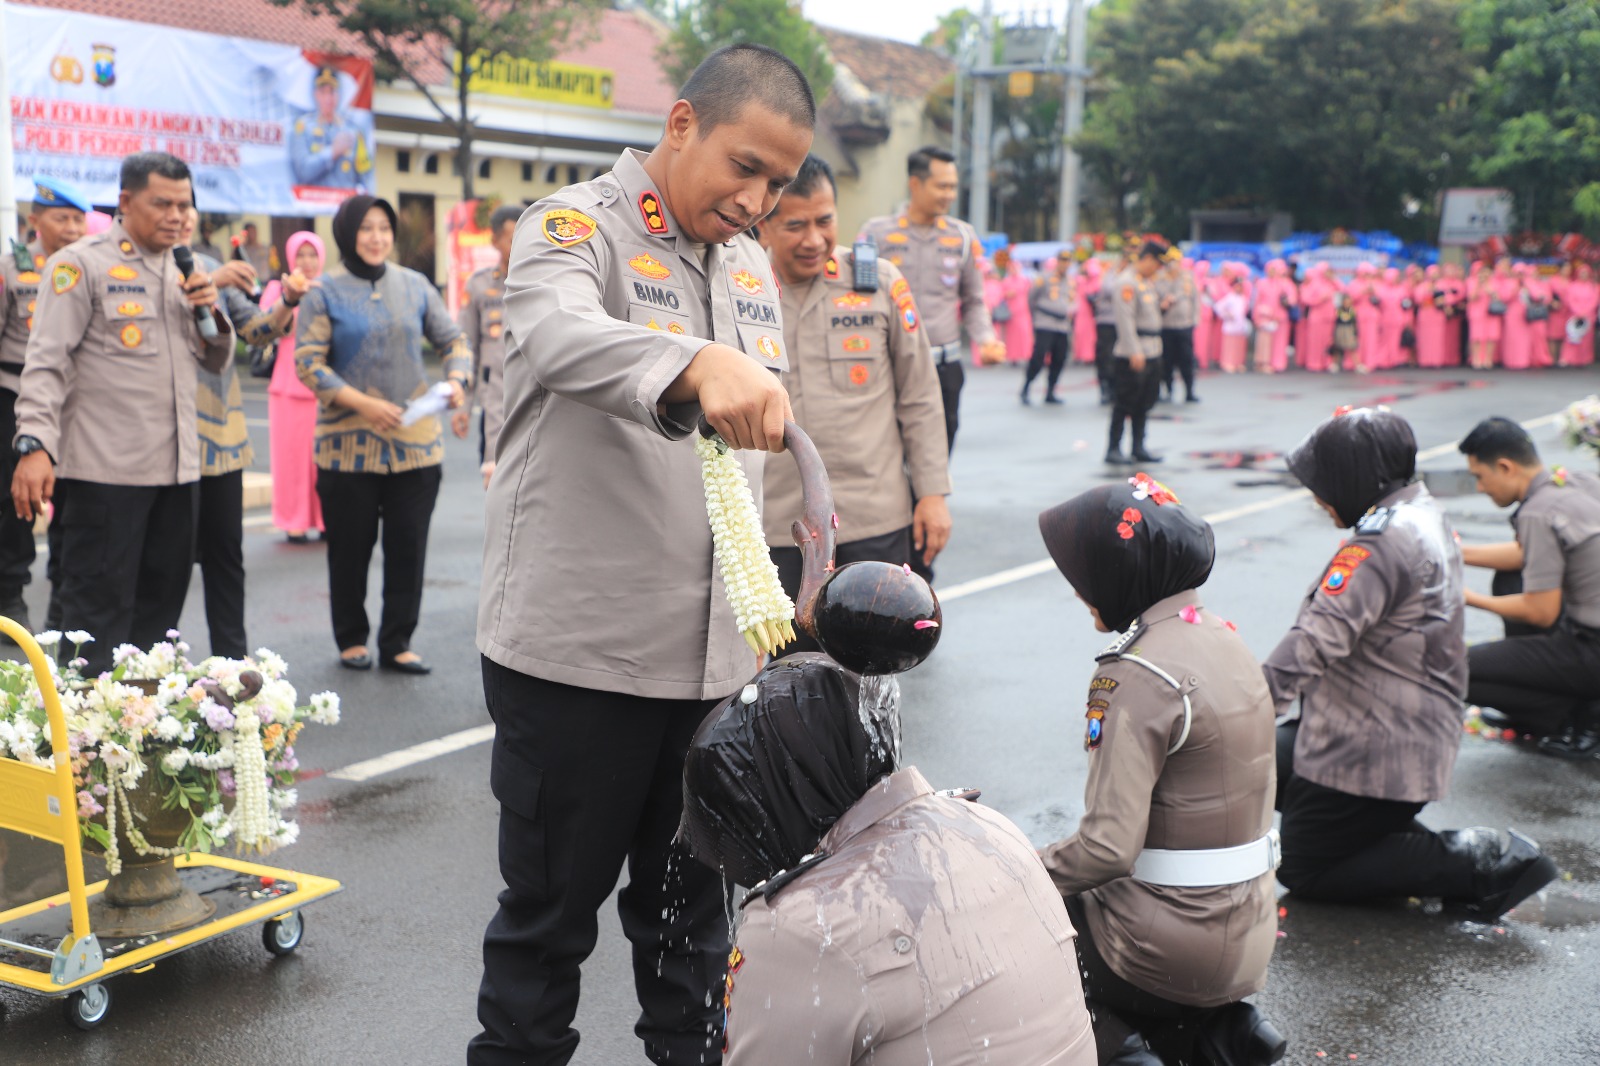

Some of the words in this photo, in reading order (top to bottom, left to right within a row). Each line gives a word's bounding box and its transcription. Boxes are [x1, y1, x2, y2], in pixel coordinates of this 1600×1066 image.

[51, 100, 136, 130] KENAIKAN
[139, 109, 214, 139] PANGKAT
[25, 125, 74, 153] POLRI
[633, 281, 680, 310] BIMO
[735, 299, 777, 324] POLRI
[831, 315, 874, 328] POLRI
